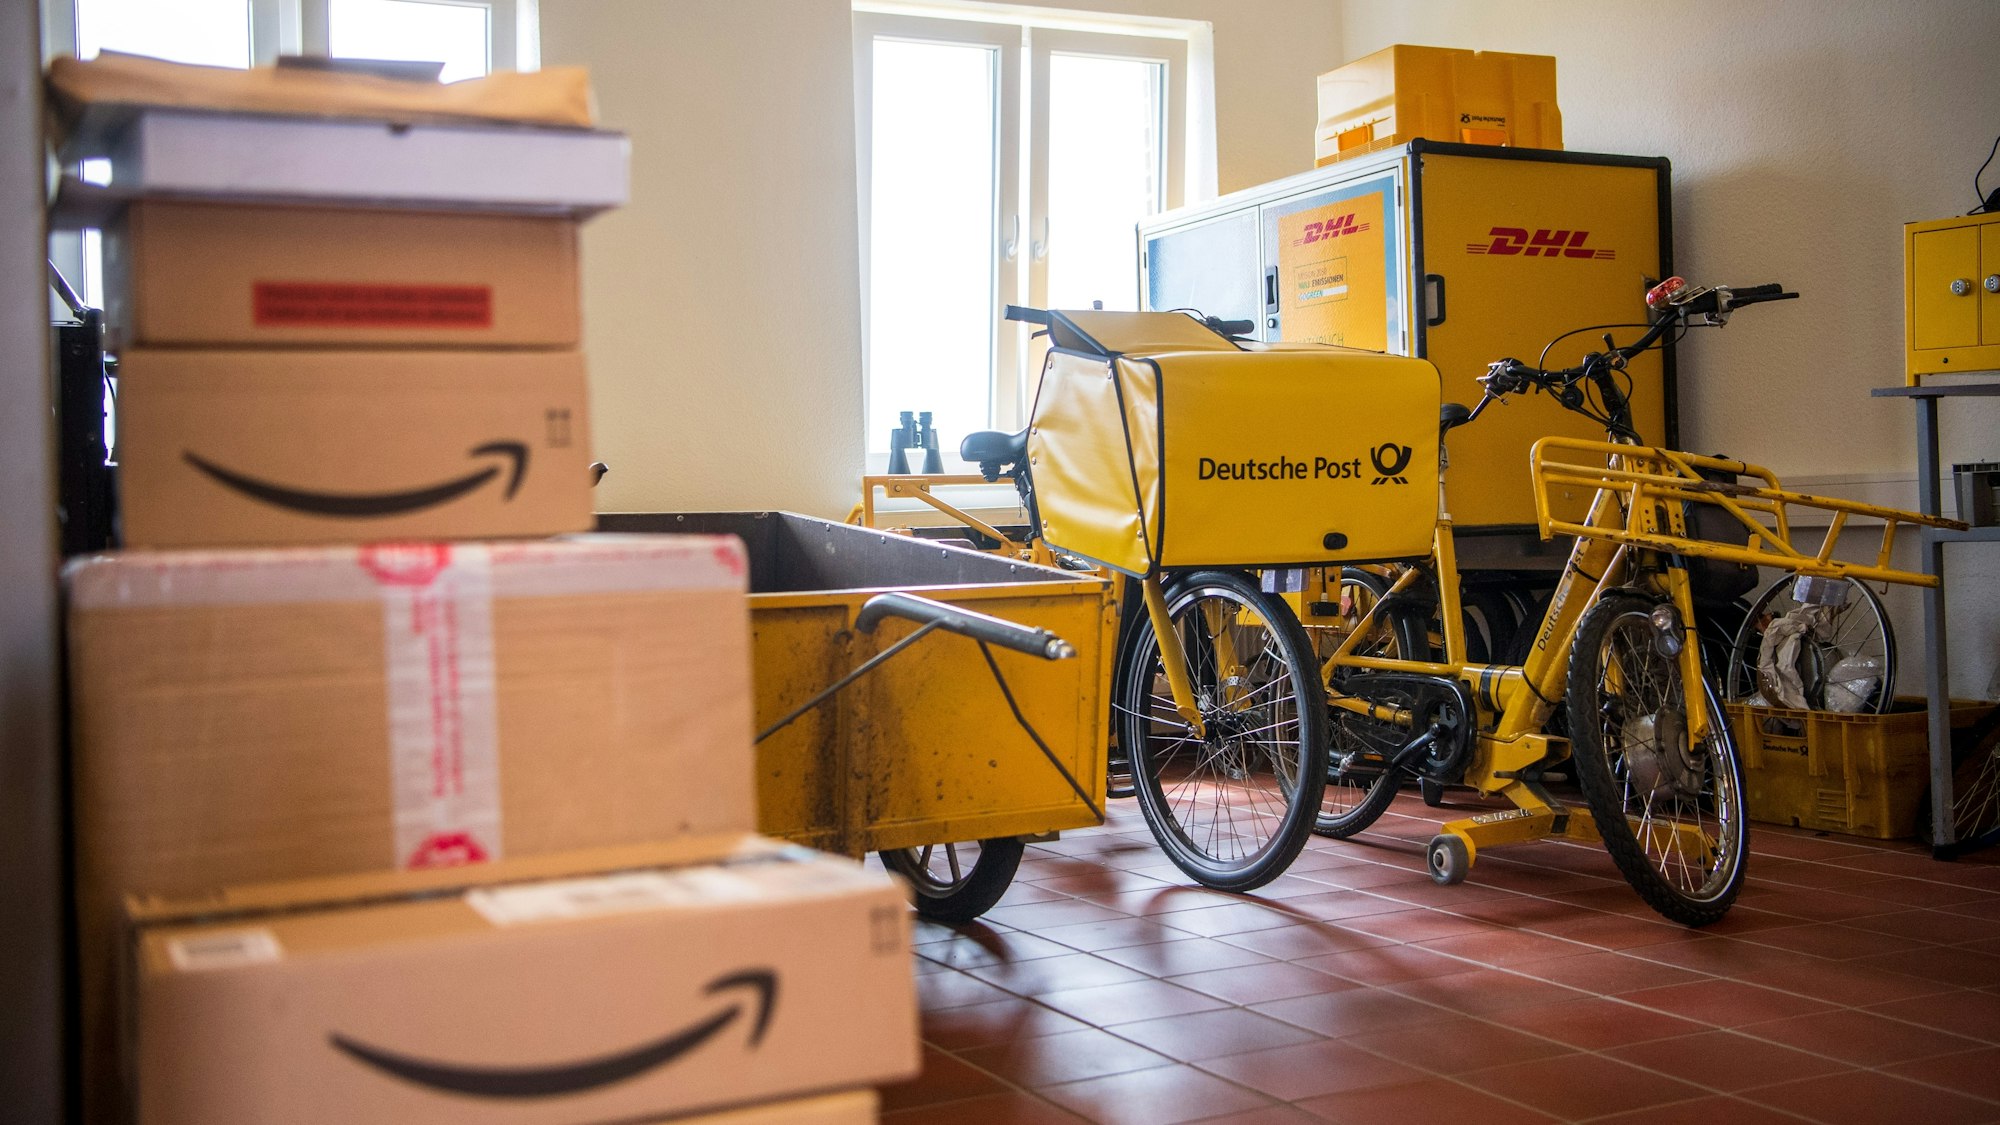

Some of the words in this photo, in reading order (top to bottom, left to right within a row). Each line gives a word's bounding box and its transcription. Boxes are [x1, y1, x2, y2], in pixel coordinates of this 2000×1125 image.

[1303, 213, 1359, 245] DHL
[1487, 227, 1596, 259] DHL
[1199, 456, 1308, 480] Deutsche
[1314, 457, 1361, 479] Post
[1537, 585, 1570, 652] Deutsche
